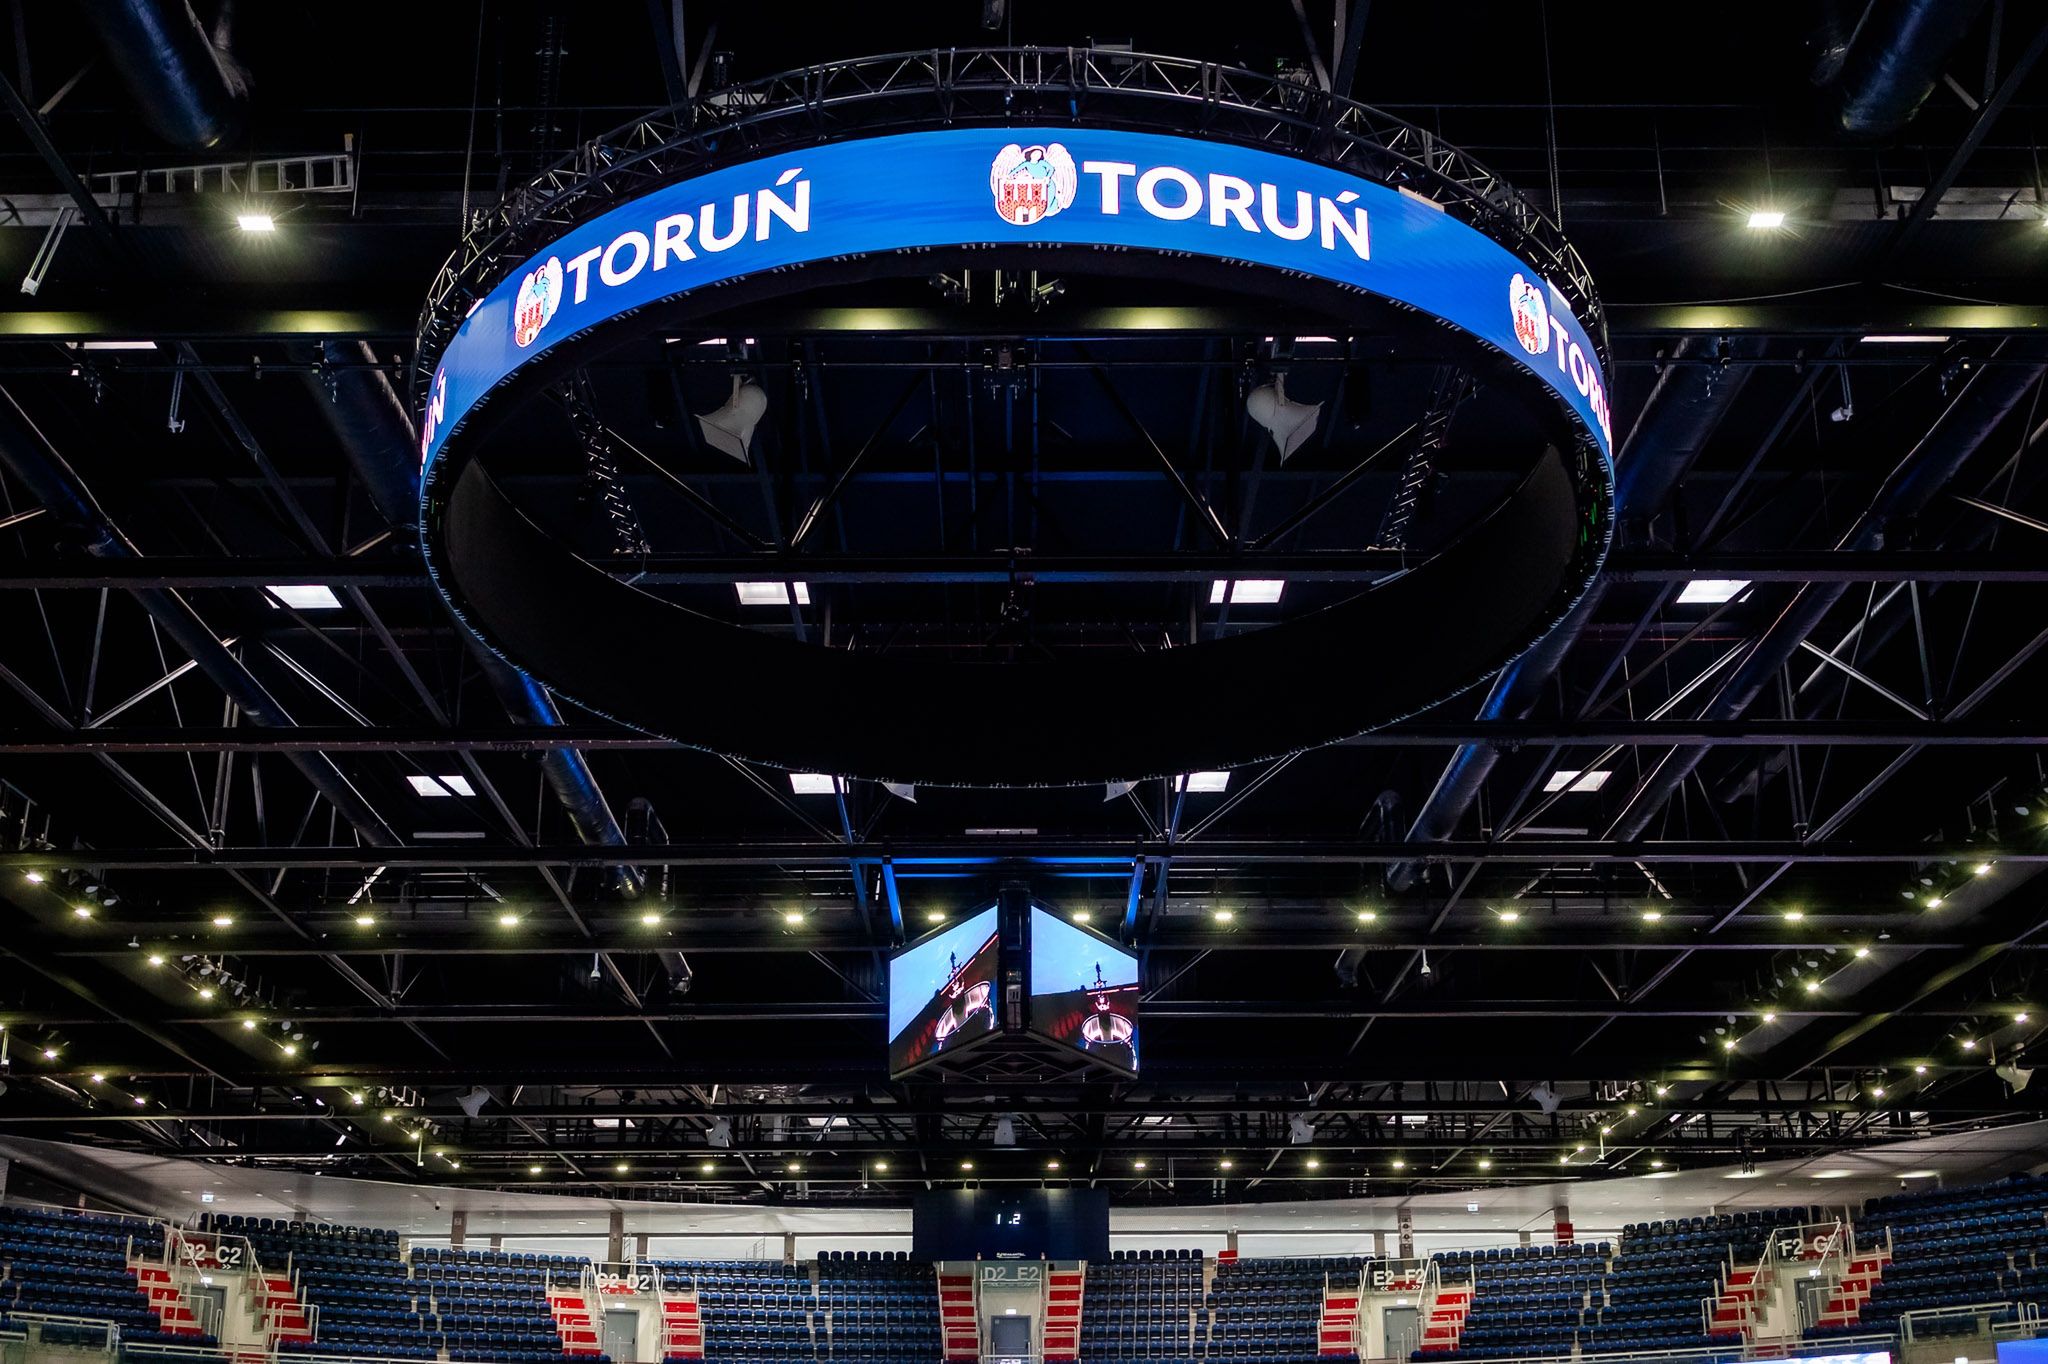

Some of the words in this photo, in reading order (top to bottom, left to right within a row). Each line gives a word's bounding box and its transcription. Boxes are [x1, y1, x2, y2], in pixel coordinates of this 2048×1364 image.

[1083, 160, 1371, 261] TORUŃ
[566, 168, 810, 305] TORUŃ
[215, 1245, 242, 1264] C2
[1781, 1238, 1804, 1257] F2
[1813, 1235, 1840, 1254] G2
[626, 1273, 650, 1290] D2
[984, 1266, 1006, 1281] D2
[1017, 1266, 1038, 1281] E2
[1373, 1269, 1395, 1286] E2
[1404, 1268, 1425, 1285] F2
